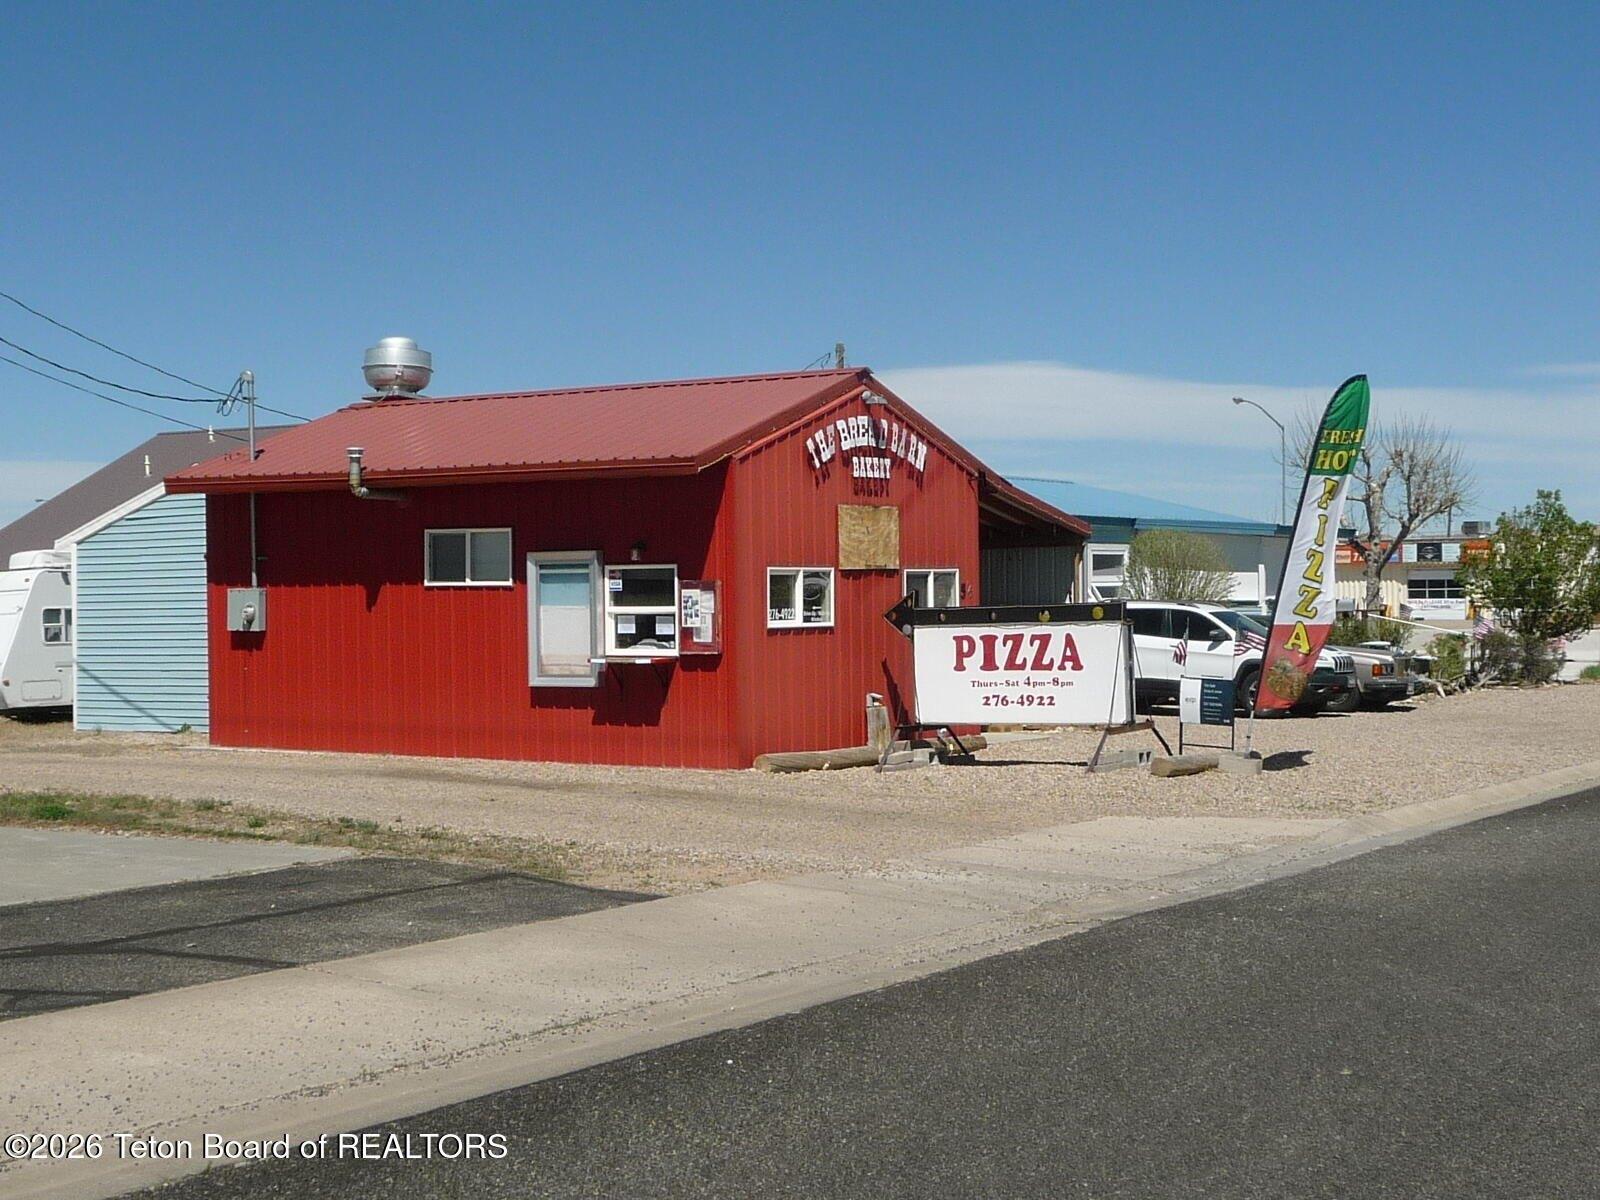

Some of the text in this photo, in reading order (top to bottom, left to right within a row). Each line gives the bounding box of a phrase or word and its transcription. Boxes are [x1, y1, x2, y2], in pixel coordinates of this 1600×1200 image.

[806, 424, 836, 469] THE
[891, 422, 928, 472] BARN
[852, 456, 892, 479] BAKERY
[1315, 449, 1356, 470] HO
[952, 632, 1084, 672] PIZZA
[970, 676, 1074, 688] Thurs-Sat 4pm-8pm
[982, 694, 1056, 706] 276-4922
